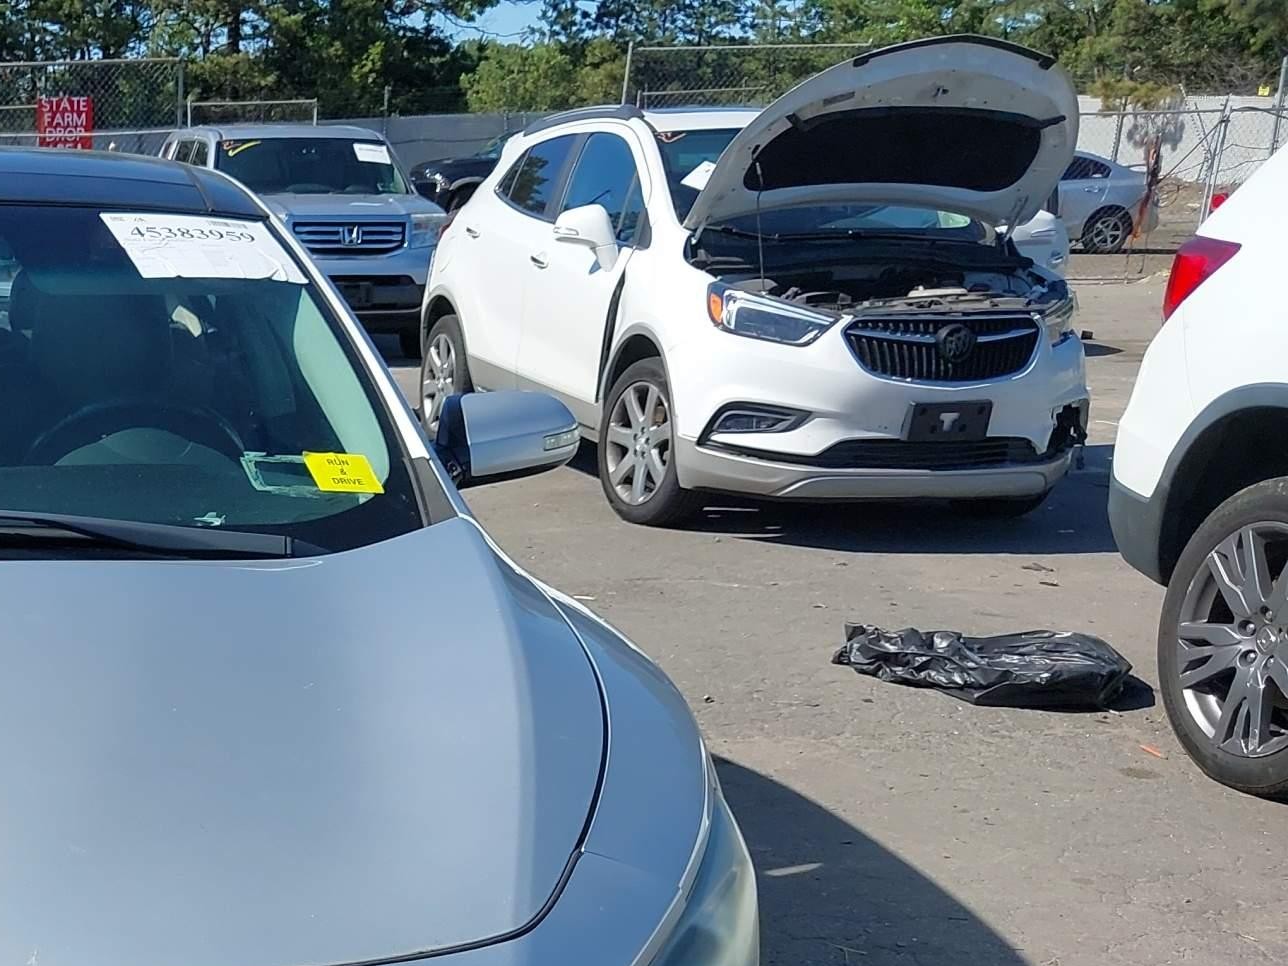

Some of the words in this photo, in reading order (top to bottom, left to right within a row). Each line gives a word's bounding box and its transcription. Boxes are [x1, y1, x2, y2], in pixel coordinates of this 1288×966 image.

[41, 97, 88, 112] STATE
[44, 112, 86, 127] FARM
[45, 127, 85, 142] DROP
[130, 226, 255, 243] 45383959
[326, 458, 350, 466] RUN
[332, 477, 365, 486] DRIVE
